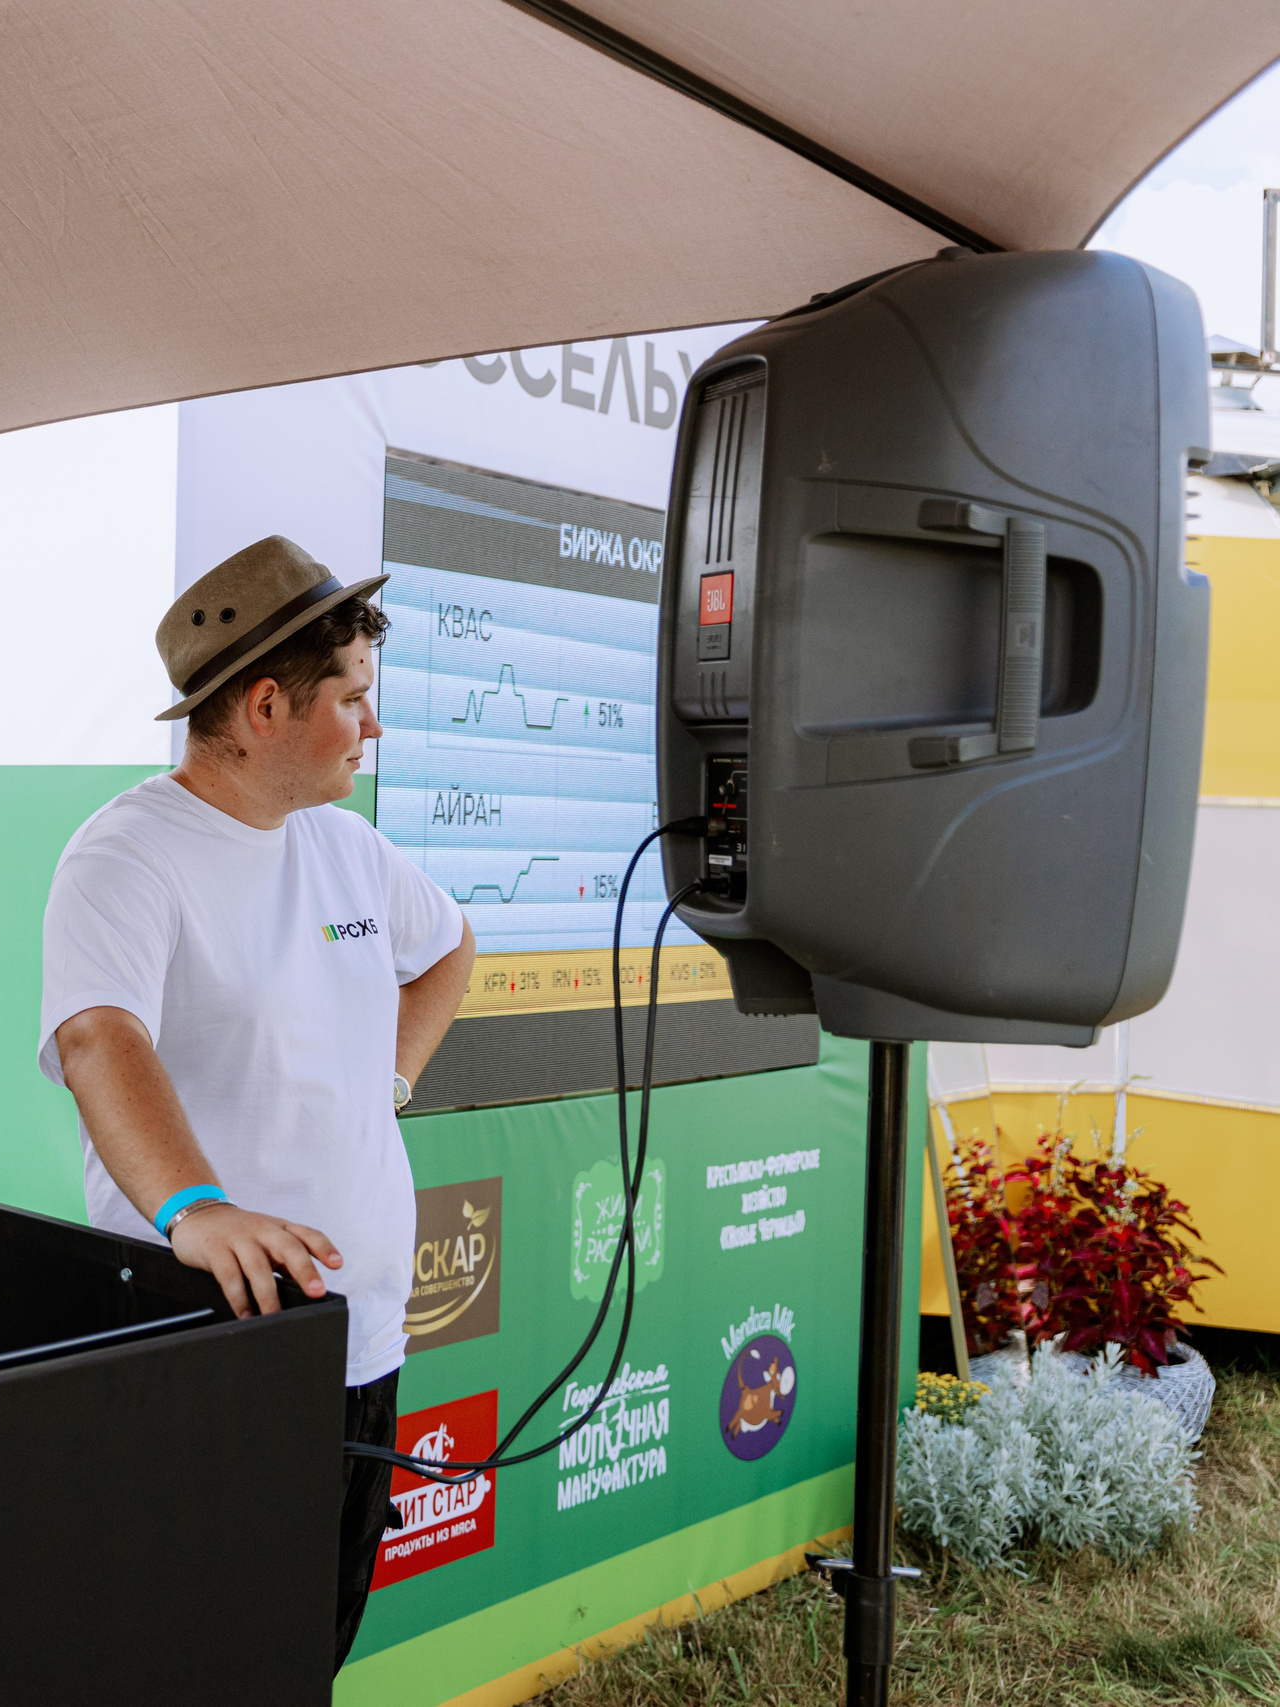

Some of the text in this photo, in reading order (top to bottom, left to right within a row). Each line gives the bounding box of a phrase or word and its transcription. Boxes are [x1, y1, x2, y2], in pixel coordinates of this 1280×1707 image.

[419, 336, 697, 430] СЕЛЬ
[560, 522, 625, 568] БИРЖА
[438, 603, 492, 641] КВАС
[706, 589, 726, 612] JBL
[598, 703, 623, 728] 51%
[432, 782, 502, 827] АЙРАН
[593, 875, 618, 898] 15%
[336, 918, 379, 940] РСХБ
[519, 971, 540, 990] 31%
[412, 1233, 486, 1282] СКАР
[557, 1445, 667, 1512] МАНУФАКТУРА
[385, 1479, 477, 1534] ИТ СТАР
[385, 1518, 477, 1562] ПРОДУКТЫ ИЗ МЯСА
